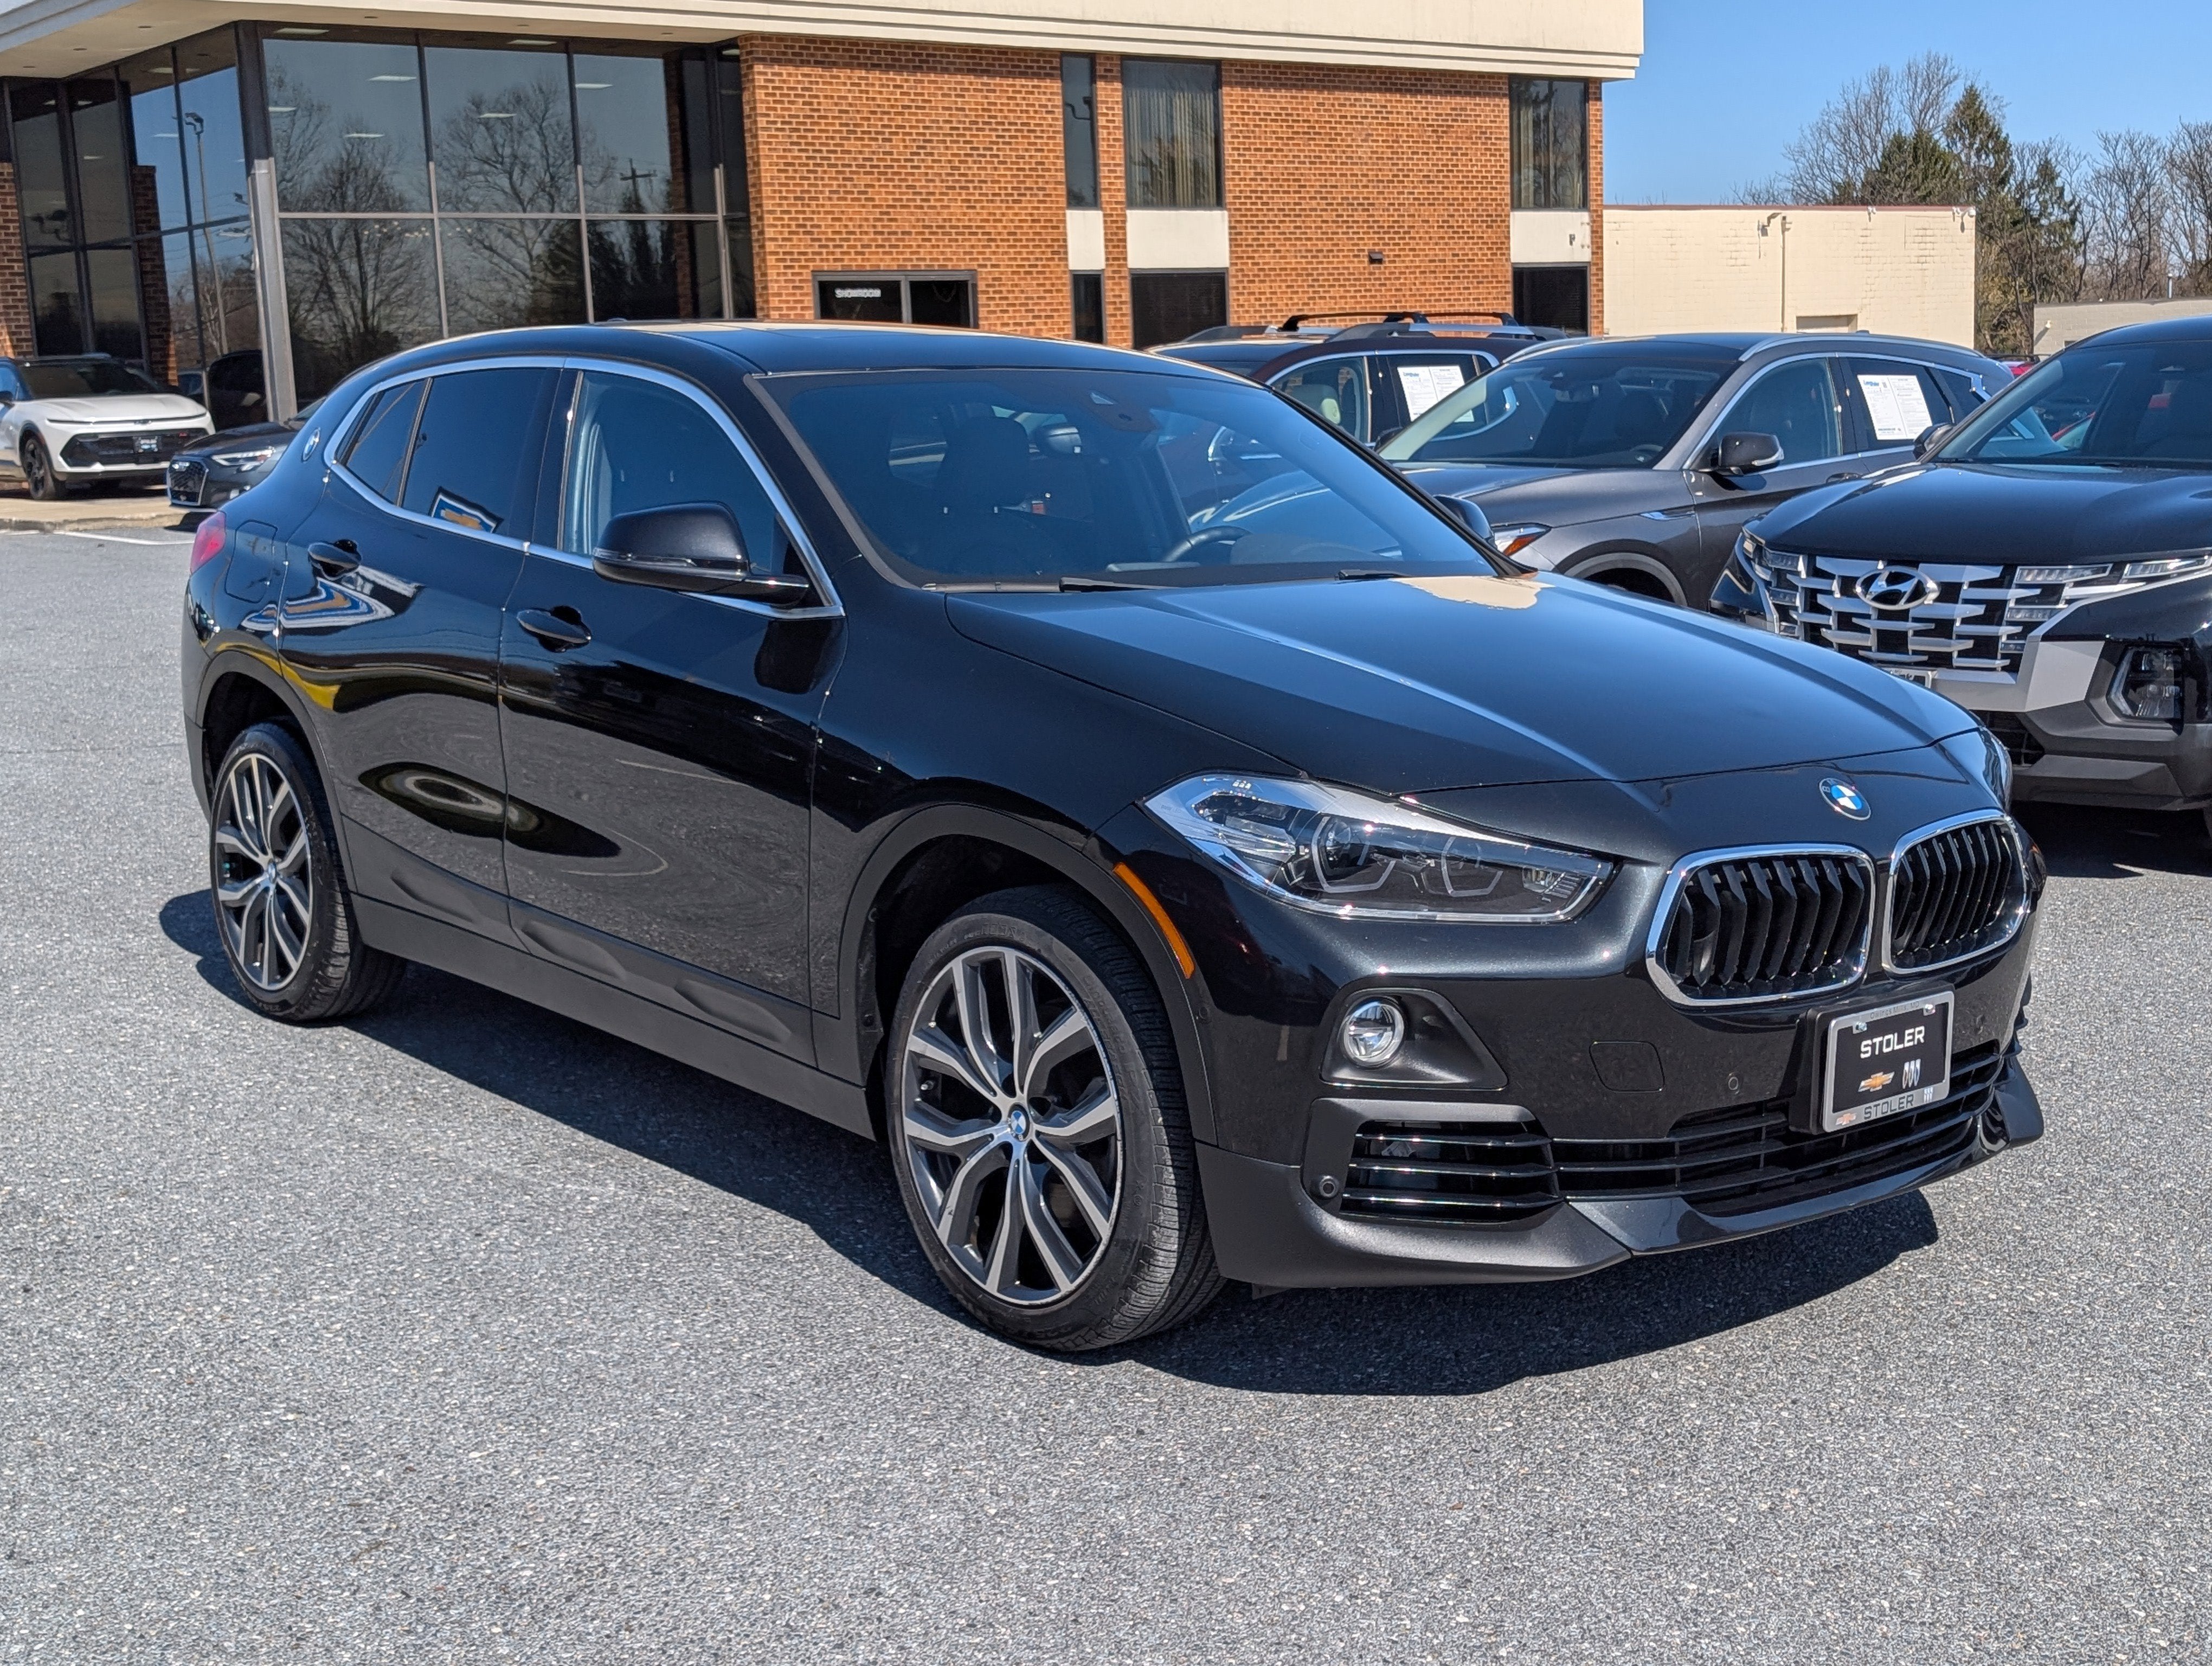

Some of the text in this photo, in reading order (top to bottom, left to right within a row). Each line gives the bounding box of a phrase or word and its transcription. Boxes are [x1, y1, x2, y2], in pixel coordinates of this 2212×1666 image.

[1870, 1009, 1892, 1019] Owings
[1860, 1026, 1925, 1058] STOLER
[1864, 1094, 1914, 1119] STOLER
